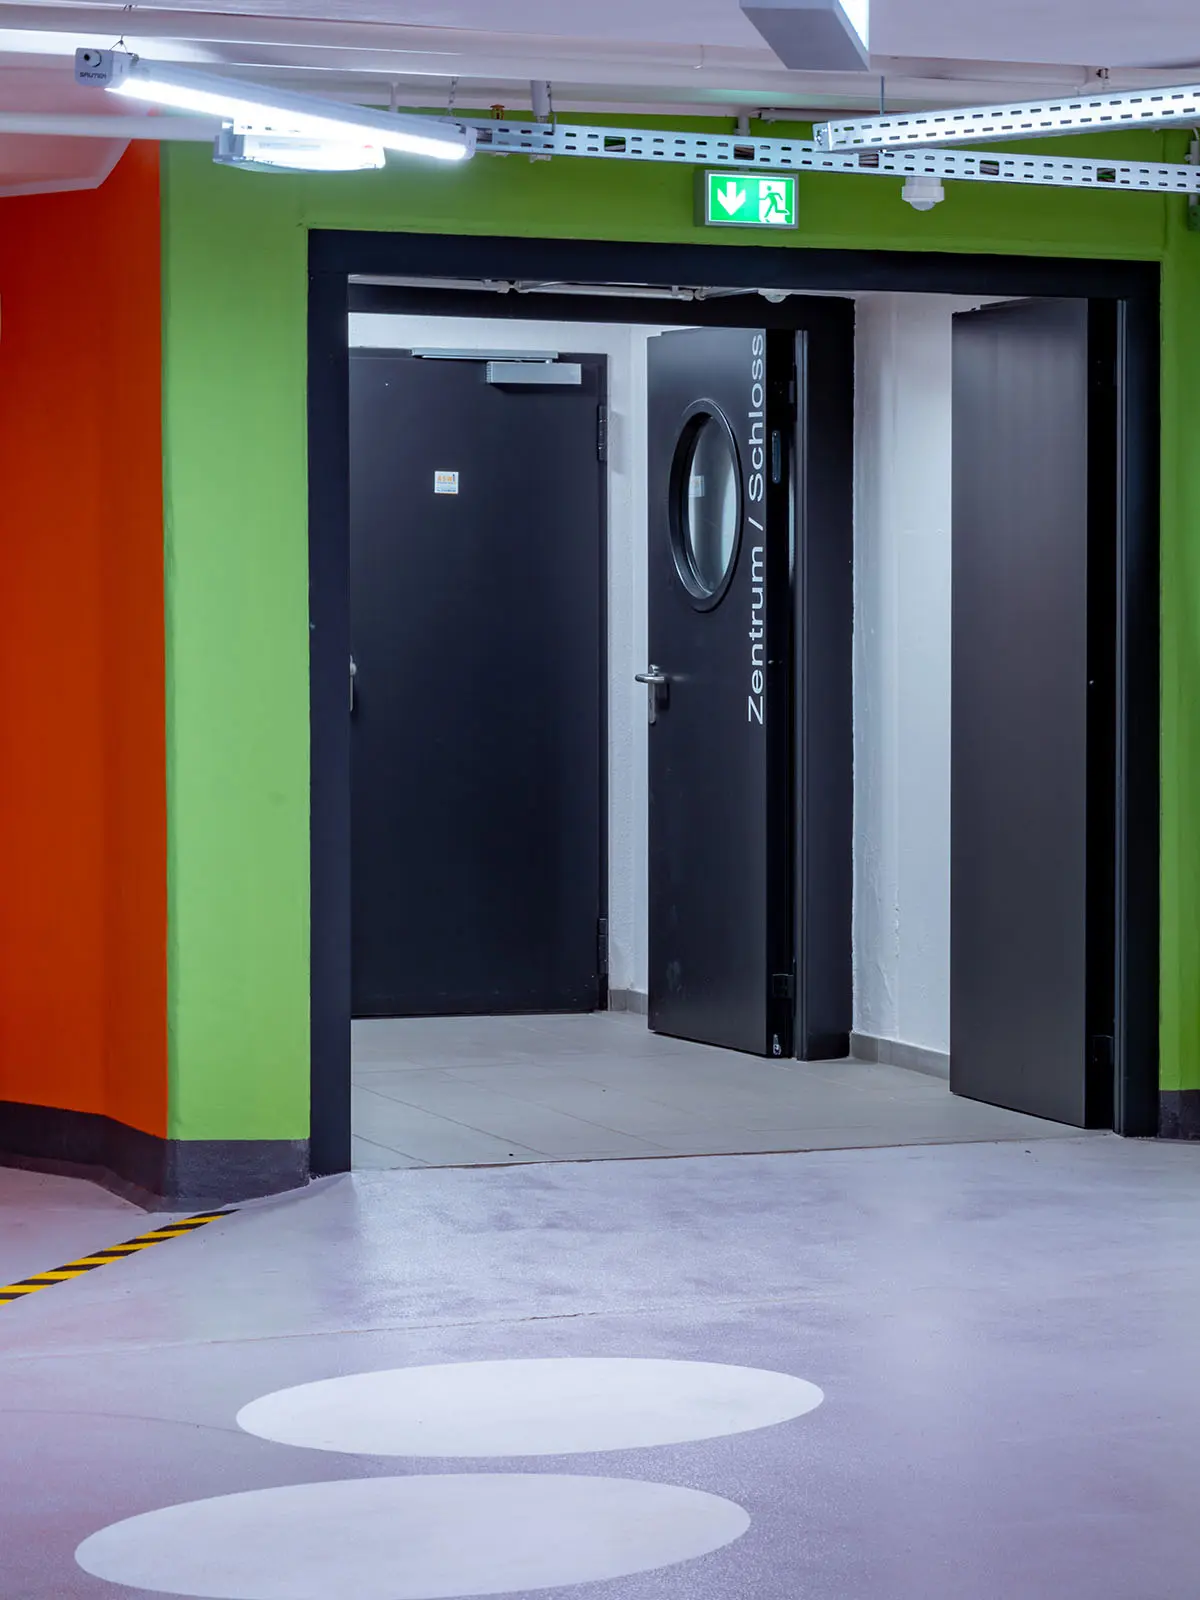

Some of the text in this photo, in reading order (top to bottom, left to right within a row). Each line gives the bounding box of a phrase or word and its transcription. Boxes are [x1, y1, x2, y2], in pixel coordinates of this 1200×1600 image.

[748, 332, 765, 725] Zentrum / Schloss
